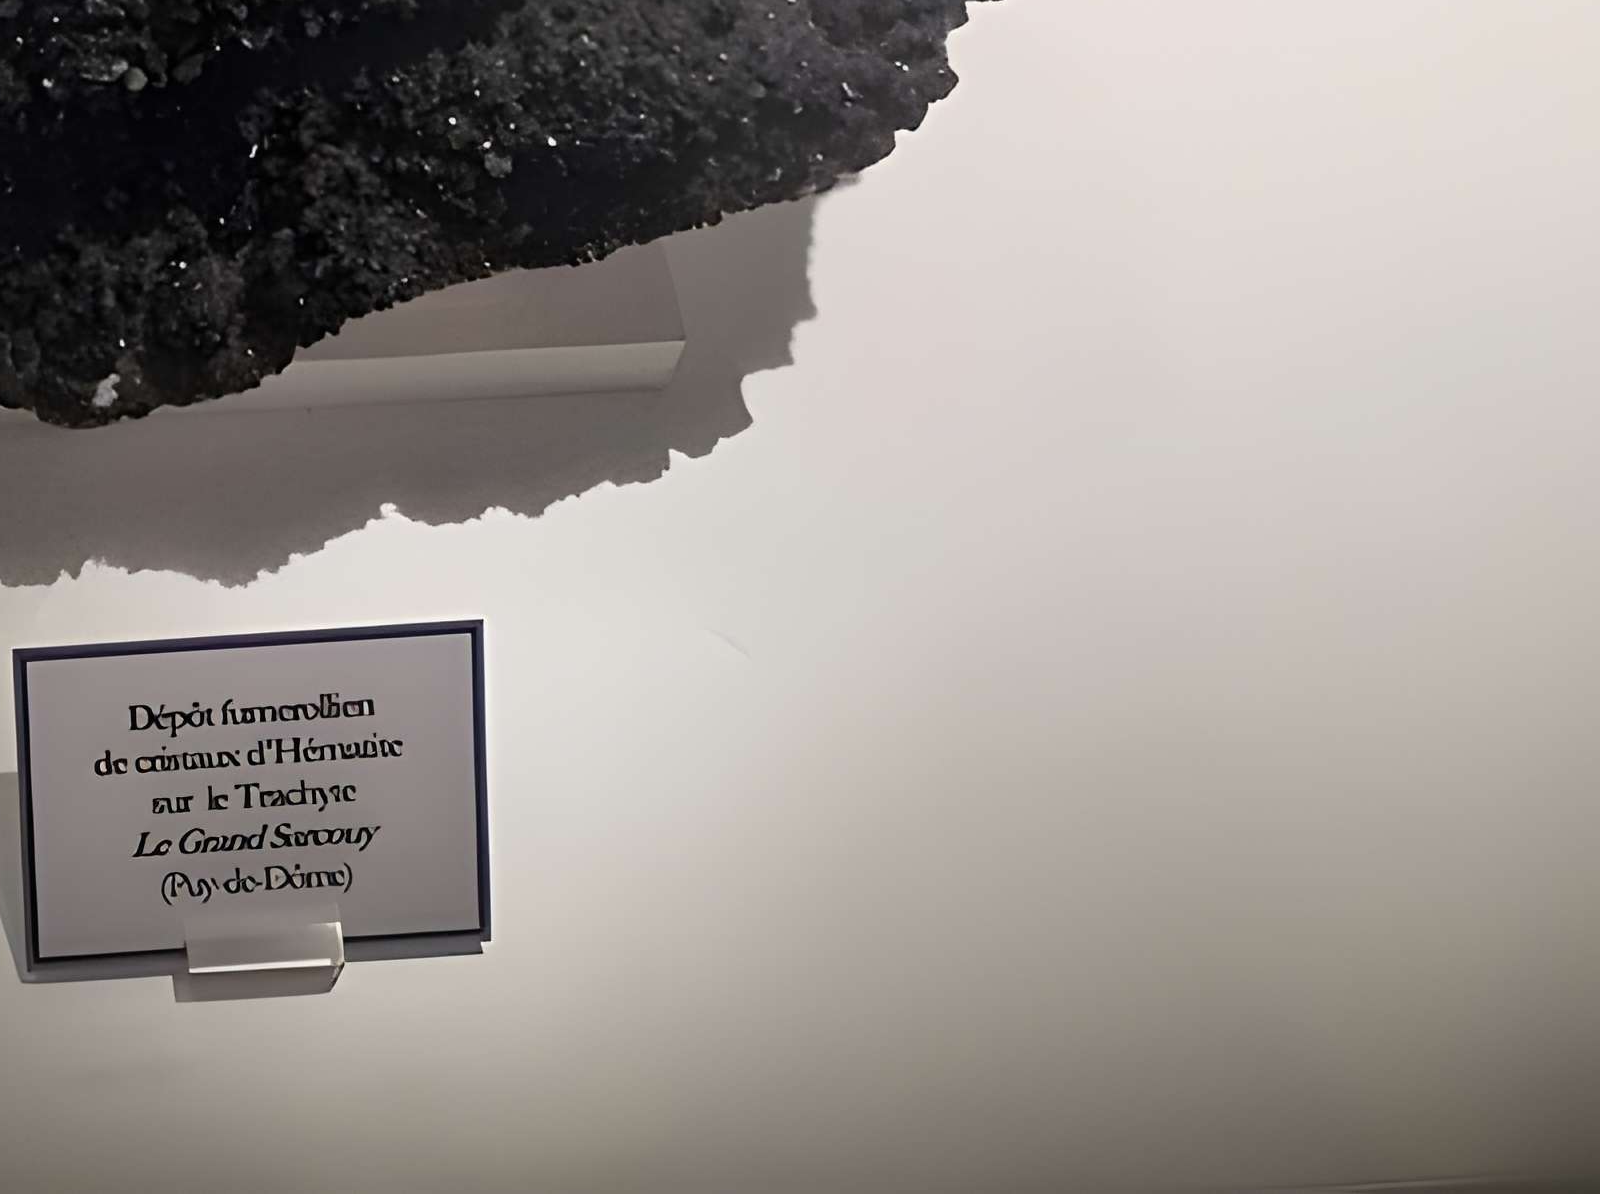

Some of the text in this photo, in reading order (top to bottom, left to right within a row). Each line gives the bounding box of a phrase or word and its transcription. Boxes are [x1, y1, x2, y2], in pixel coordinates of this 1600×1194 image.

[94, 749, 128, 776] de
[208, 785, 229, 811] le
[132, 831, 173, 858] Le
[178, 824, 269, 855] Grand
